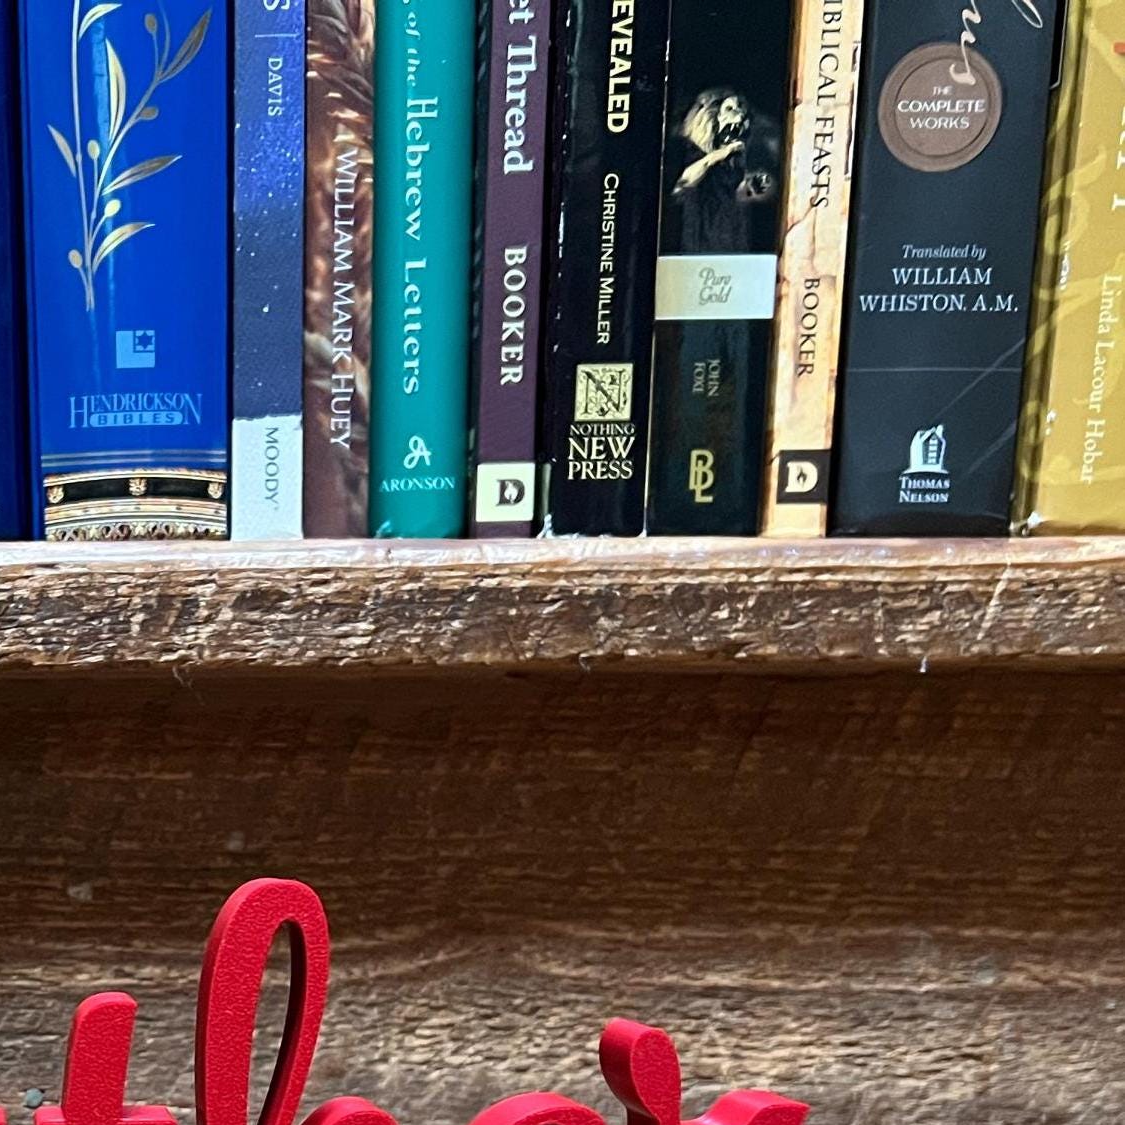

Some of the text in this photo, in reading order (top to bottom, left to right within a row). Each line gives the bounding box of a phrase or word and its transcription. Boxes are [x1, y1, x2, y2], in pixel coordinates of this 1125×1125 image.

[268, 57, 284, 117] DAVIS
[933, 85, 954, 96] THE
[504, 35, 538, 175] Thread
[897, 99, 986, 113] COMPLETE
[909, 116, 970, 130] WORKS
[405, 97, 438, 241] Hebrew
[809, 116, 835, 209] FEASTS
[596, 173, 620, 345] CHRISTINE MILLER
[902, 244, 987, 261] Translated by
[699, 266, 732, 287] Pure
[892, 267, 992, 285] WILLIAM
[329, 148, 358, 450] WILLIAM MARK HUEY
[699, 285, 732, 306] Gold
[971, 293, 1018, 312] A.M.
[403, 257, 427, 395] Letters
[500, 246, 528, 386] BOOKER
[797, 277, 821, 377] BOOKER
[708, 359, 720, 396] JOHN
[1080, 274, 1123, 485] Linda Lacour Hobar
[69, 392, 203, 429] HENDRICKSON
[97, 413, 175, 426] BIBLES
[569, 423, 635, 436] NOTHING
[568, 436, 635, 460] NEW
[567, 460, 633, 480] PRESS
[379, 476, 455, 492] ARONSON
[899, 475, 951, 490] THOMAS
[898, 490, 949, 503] NELSON
